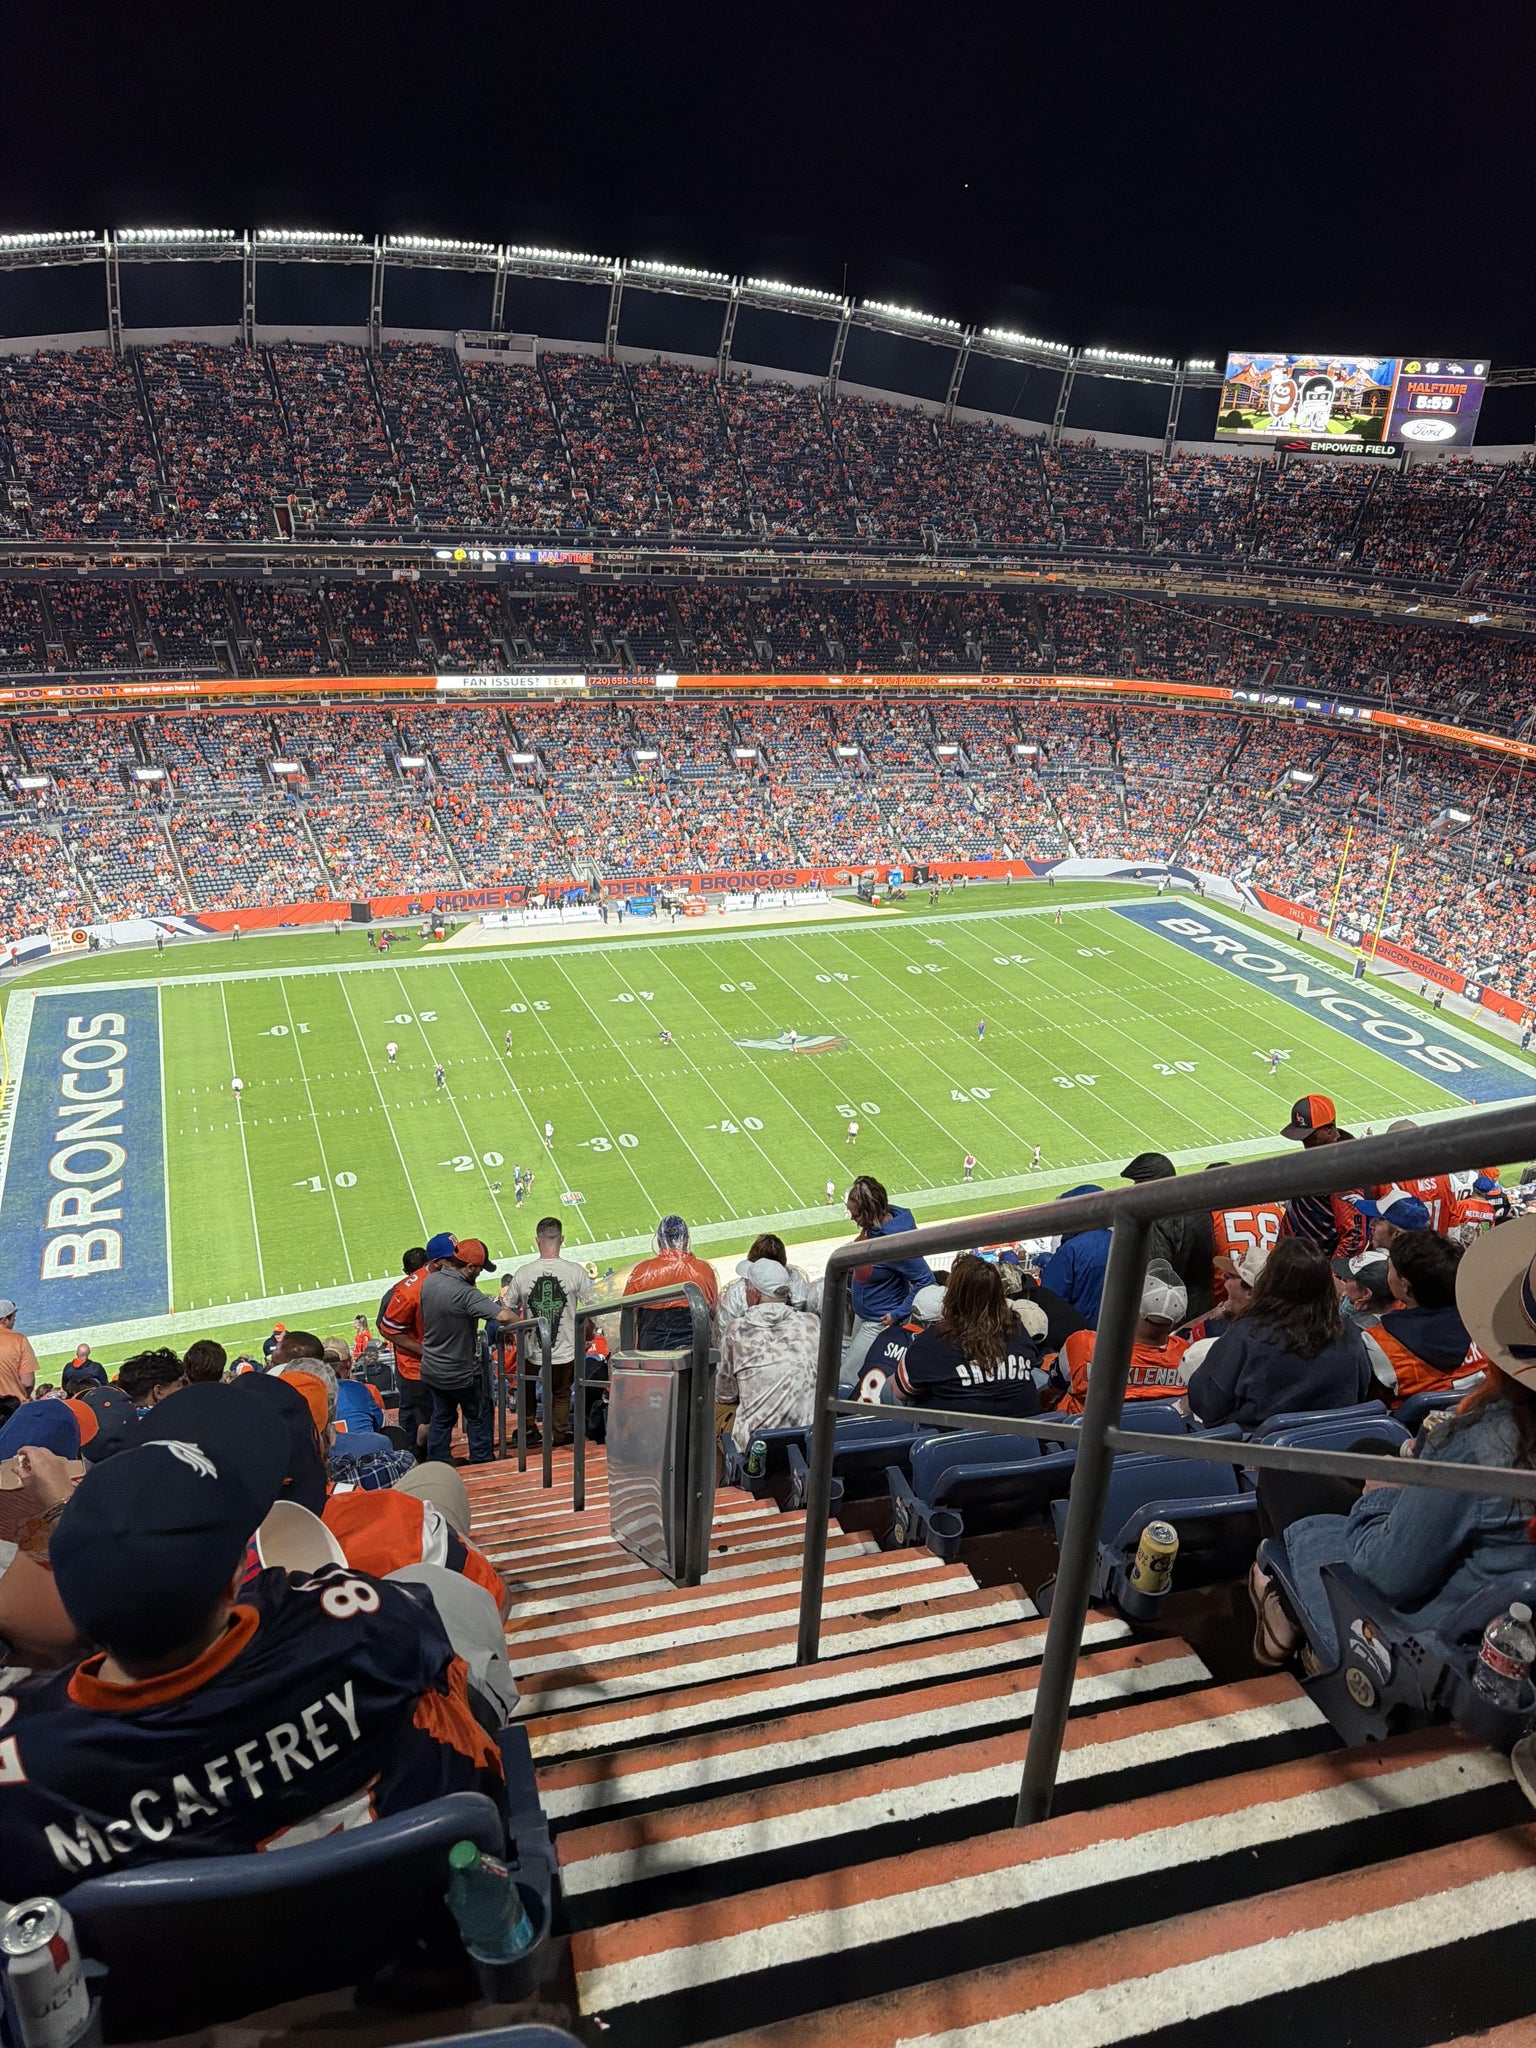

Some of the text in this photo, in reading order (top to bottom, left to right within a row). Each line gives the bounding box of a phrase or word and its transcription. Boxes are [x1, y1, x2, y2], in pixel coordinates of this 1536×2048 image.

[1474, 364, 1483, 375] 0
[1407, 382, 1467, 394] HALFTIME
[1416, 395, 1453, 409] 5:59
[1411, 422, 1444, 437] Ford
[1310, 442, 1396, 455] EMPOWER FIELD
[537, 551, 594, 564] HALFTIME
[1302, 584, 1338, 592] GRADISHAR
[1438, 598, 1470, 608] THOMPSON
[463, 677, 575, 687] FAN ISSUES? TEXT
[588, 677, 611, 686] (720)
[133, 686, 150, 694] every
[436, 891, 501, 911] HOME
[607, 878, 693, 898] DENVER
[700, 872, 798, 890] BRONCOS
[1288, 908, 1318, 924] THIS IS
[1077, 946, 1109, 957] 10
[993, 954, 1031, 965] 20
[906, 963, 943, 974] 30
[1412, 960, 1456, 985] COUNTRY
[815, 972, 850, 984] 40
[1273, 943, 1434, 1021] IT TAKES ALL OF US
[719, 981, 758, 993] 50
[1465, 983, 1480, 999] 25
[618, 991, 656, 1003] 40
[1157, 917, 1482, 1073] BRONCOS
[510, 1000, 551, 1013] 30
[394, 1011, 438, 1025] 20
[270, 1022, 312, 1036] 10
[1152, 1060, 1197, 1076] 20
[1052, 1073, 1097, 1089] 30
[950, 1086, 991, 1103] 40
[835, 1101, 882, 1119] 50
[720, 1116, 764, 1135] 40
[41, 1012, 127, 1280] BRONCOS
[590, 1132, 640, 1153] 30
[451, 1151, 505, 1172] 20
[307, 1171, 358, 1193] 10
[1222, 1211, 1282, 1261] 58
[405, 1274, 419, 1287] 2
[321, 1580, 380, 1619] 8
[44, 1680, 361, 1872] McCAFFREY
